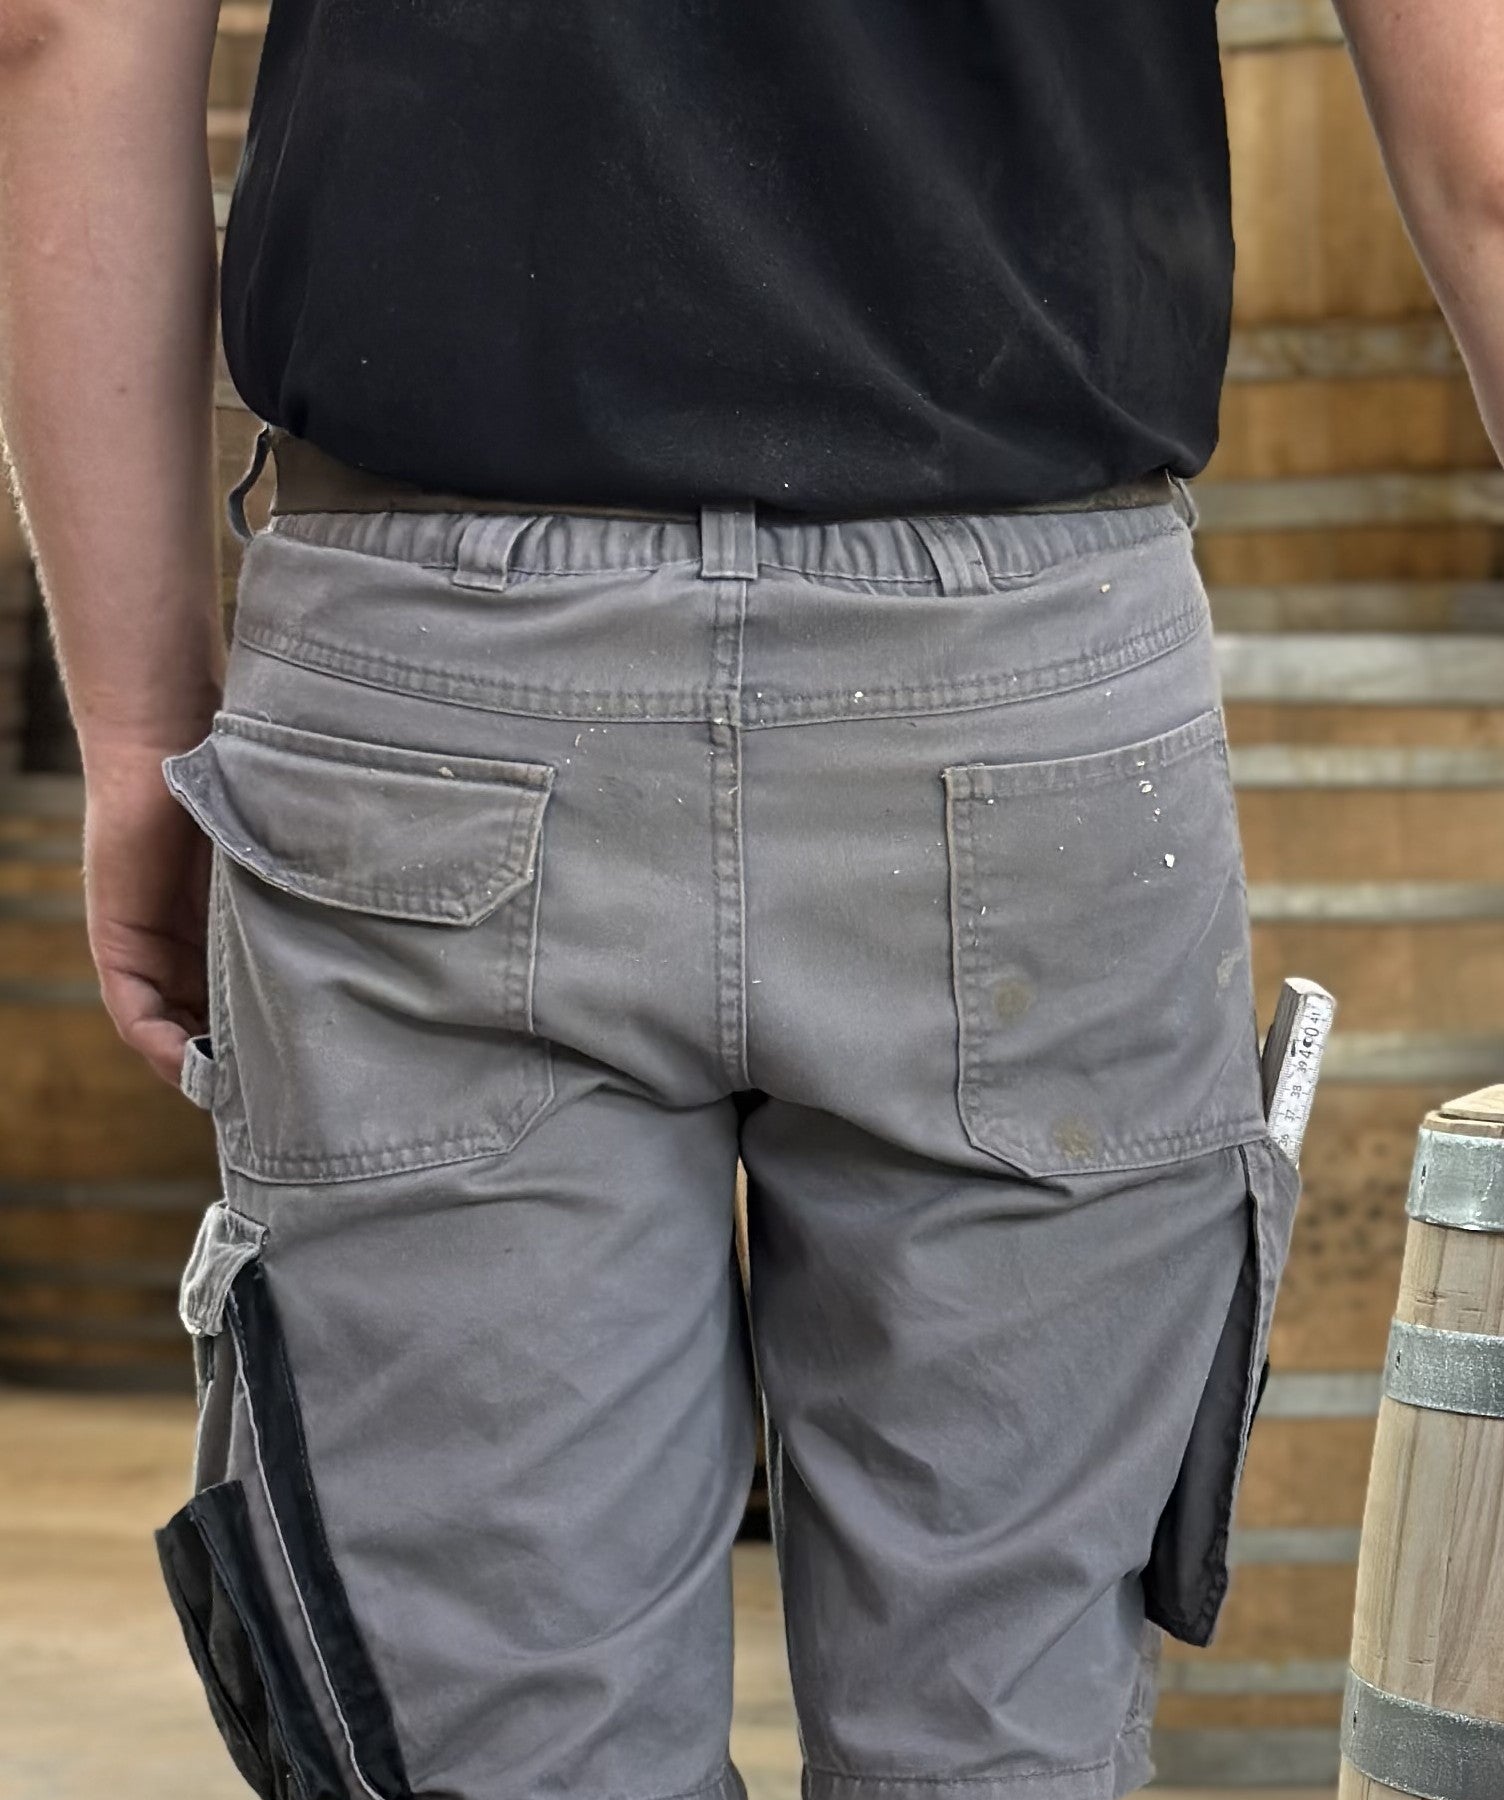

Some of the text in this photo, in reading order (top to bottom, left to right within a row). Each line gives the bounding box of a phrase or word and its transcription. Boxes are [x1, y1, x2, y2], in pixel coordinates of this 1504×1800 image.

[1284, 1109, 1296, 1122] 37
[1290, 1085, 1302, 1100] 38
[1296, 1060, 1308, 1074] 39
